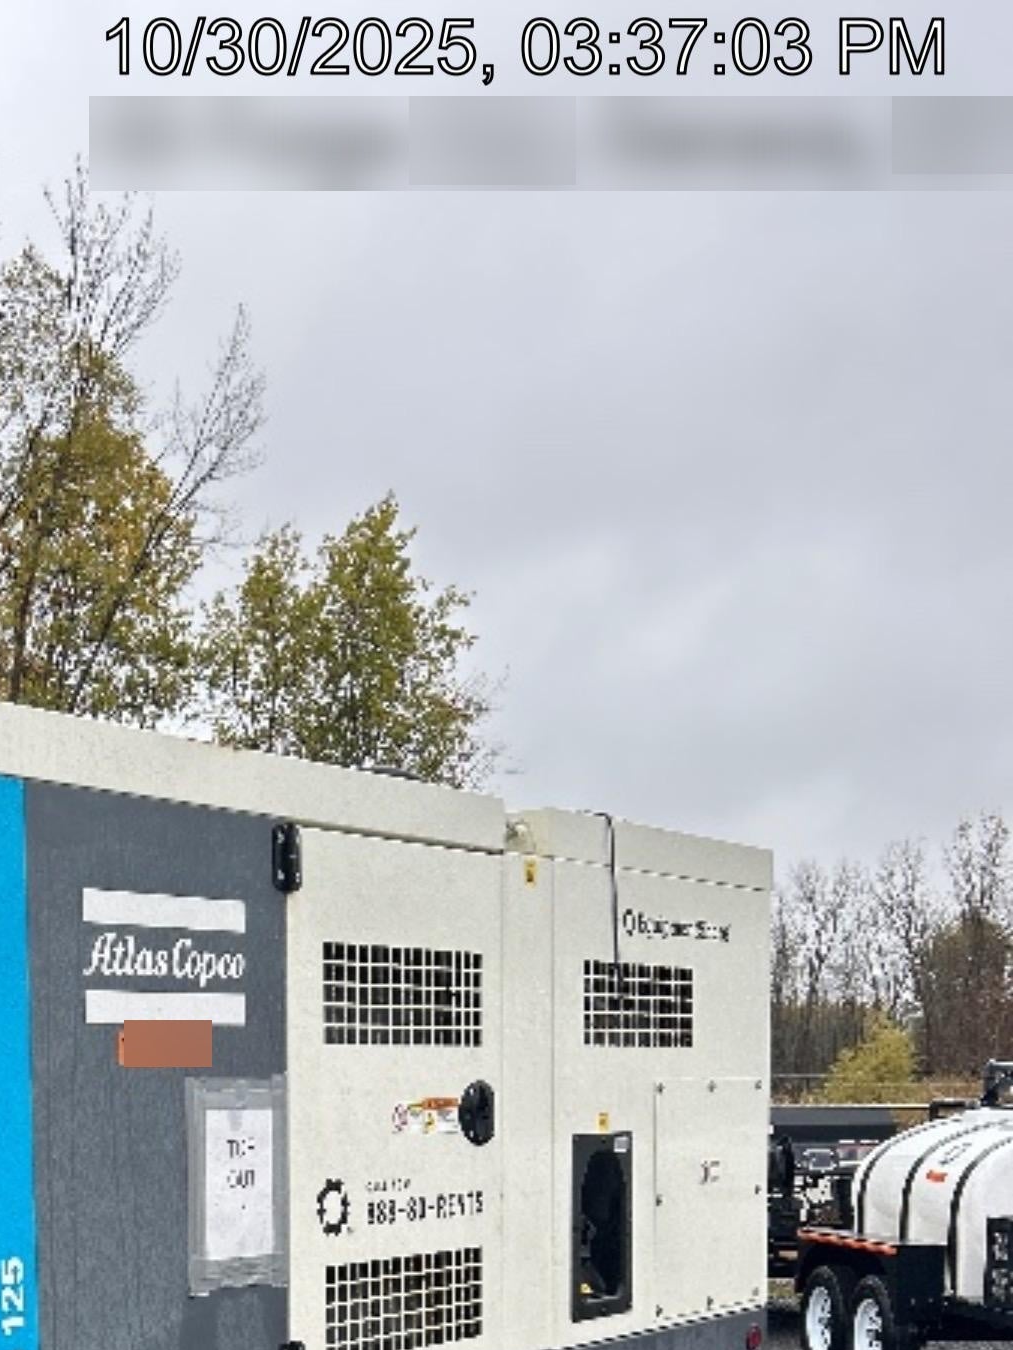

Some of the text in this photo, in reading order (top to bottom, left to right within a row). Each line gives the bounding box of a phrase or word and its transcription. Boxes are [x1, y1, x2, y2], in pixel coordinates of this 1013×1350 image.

[82, 932, 246, 988] Atlas Copco
[0, 1256, 25, 1336] 125
